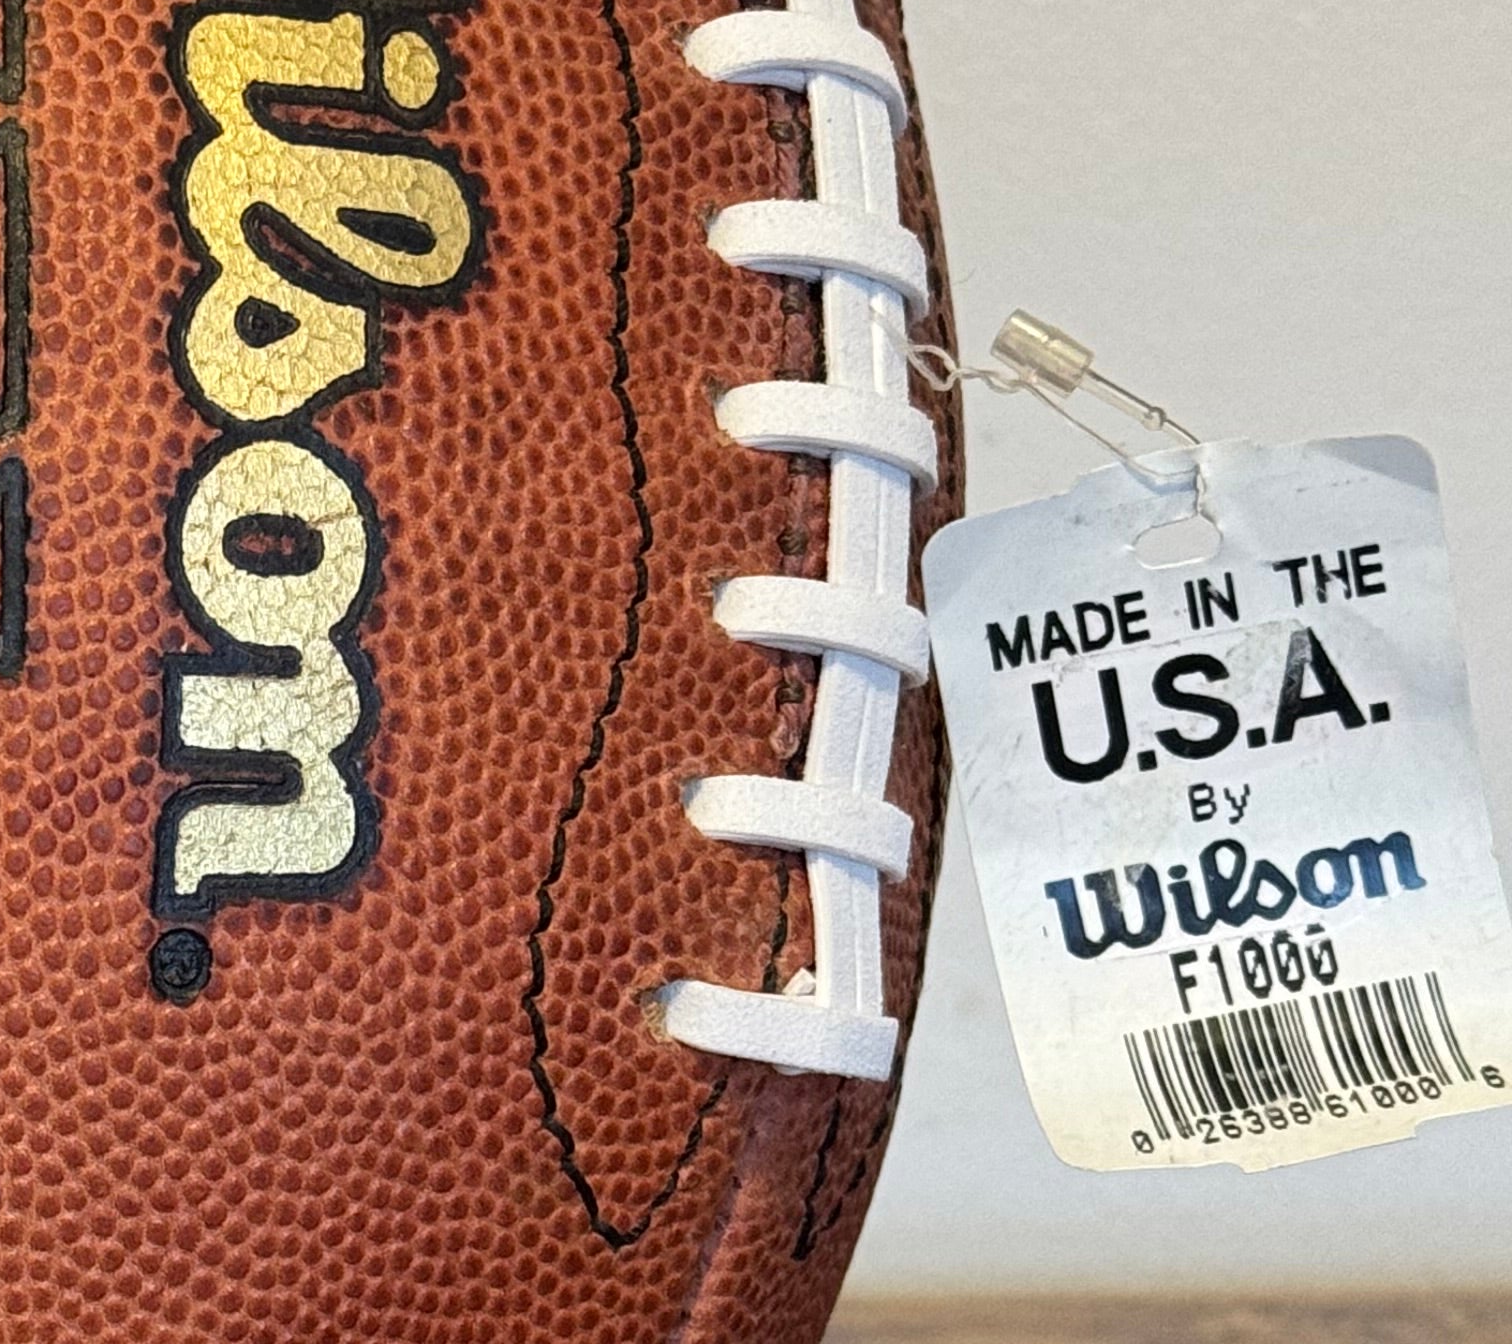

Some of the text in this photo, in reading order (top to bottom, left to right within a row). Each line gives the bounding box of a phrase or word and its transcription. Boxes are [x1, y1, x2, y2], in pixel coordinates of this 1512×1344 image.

[986, 544, 1386, 671] MADE IN THE
[1031, 627, 1391, 784] U.S.A.
[1188, 782, 1250, 825] By
[1044, 830, 1427, 959] Wilson
[1169, 923, 1338, 1014] F1000
[1132, 1130, 1155, 1154] 0
[1478, 1064, 1506, 1089] 6
